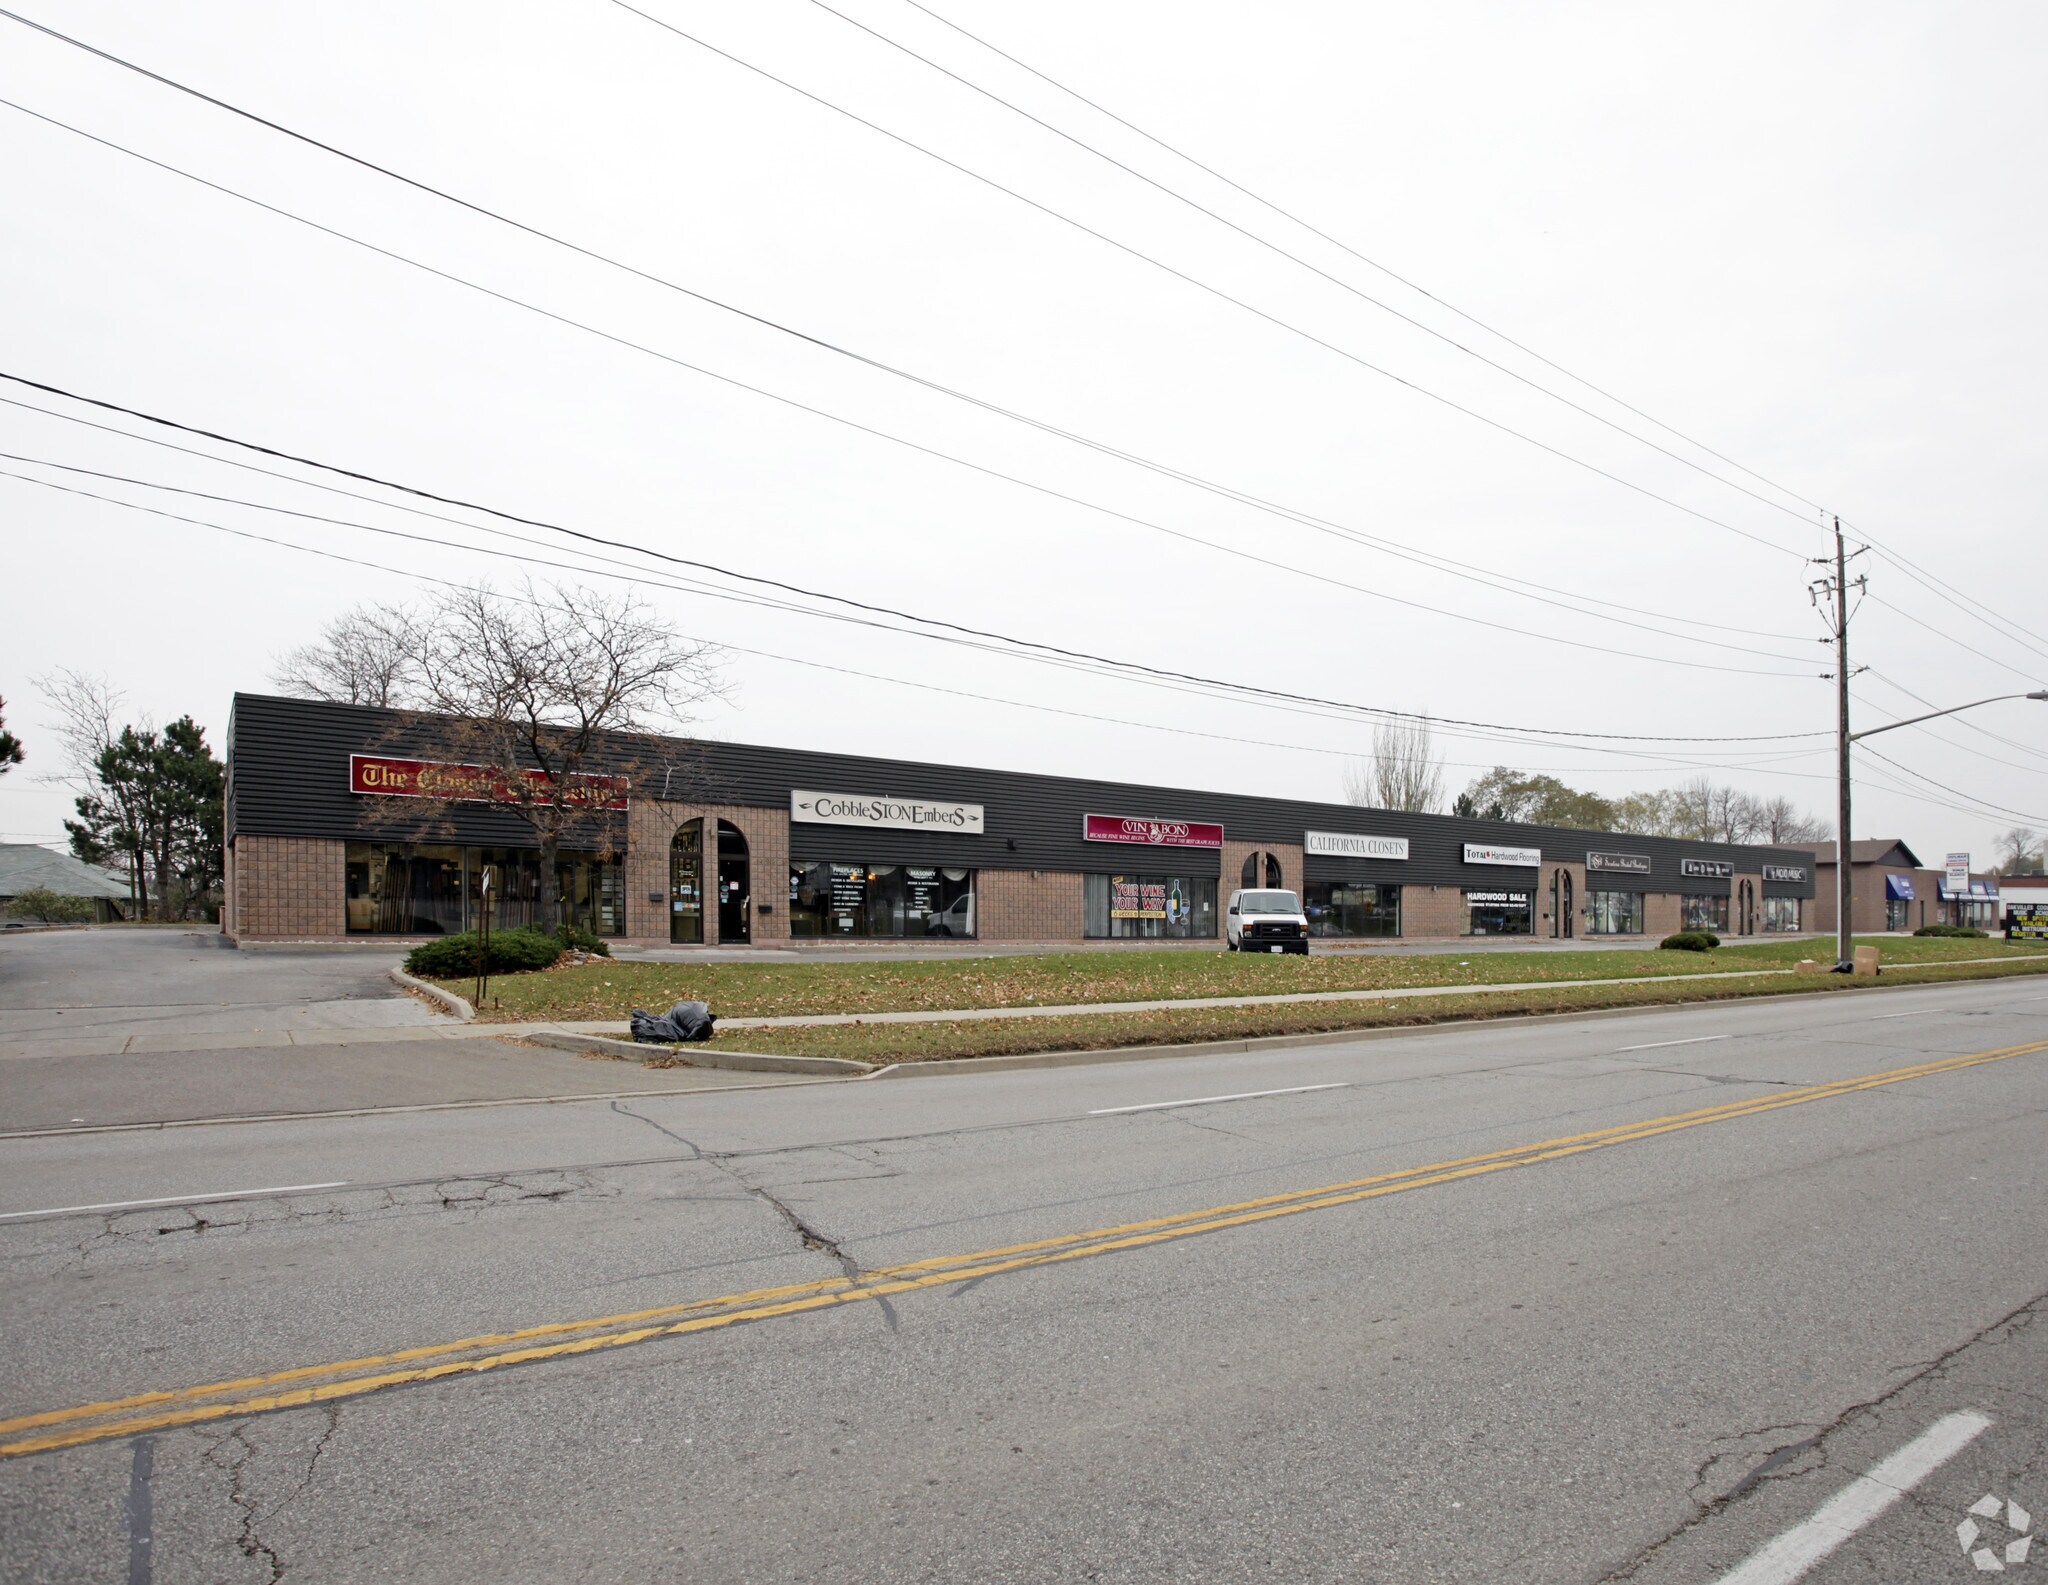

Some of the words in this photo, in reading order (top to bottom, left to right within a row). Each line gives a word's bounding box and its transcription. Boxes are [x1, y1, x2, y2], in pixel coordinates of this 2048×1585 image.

[362, 763, 408, 788] The
[1124, 821, 1147, 833] VIN
[1161, 824, 1186, 836] BON
[1309, 835, 1366, 853] CALIFORNIA
[1368, 839, 1404, 855] CLOSETS
[1491, 850, 1518, 861] Hardwood
[1519, 852, 1540, 864] Flooring
[832, 866, 864, 874] FIREPLACES
[1115, 883, 1139, 897] YOUR
[1140, 884, 1166, 897] WINE
[1467, 892, 1507, 901] HARDWOOD
[1509, 893, 1527, 902] SALE
[1112, 896, 1139, 910] YOUR
[1142, 897, 1166, 911] WAY
